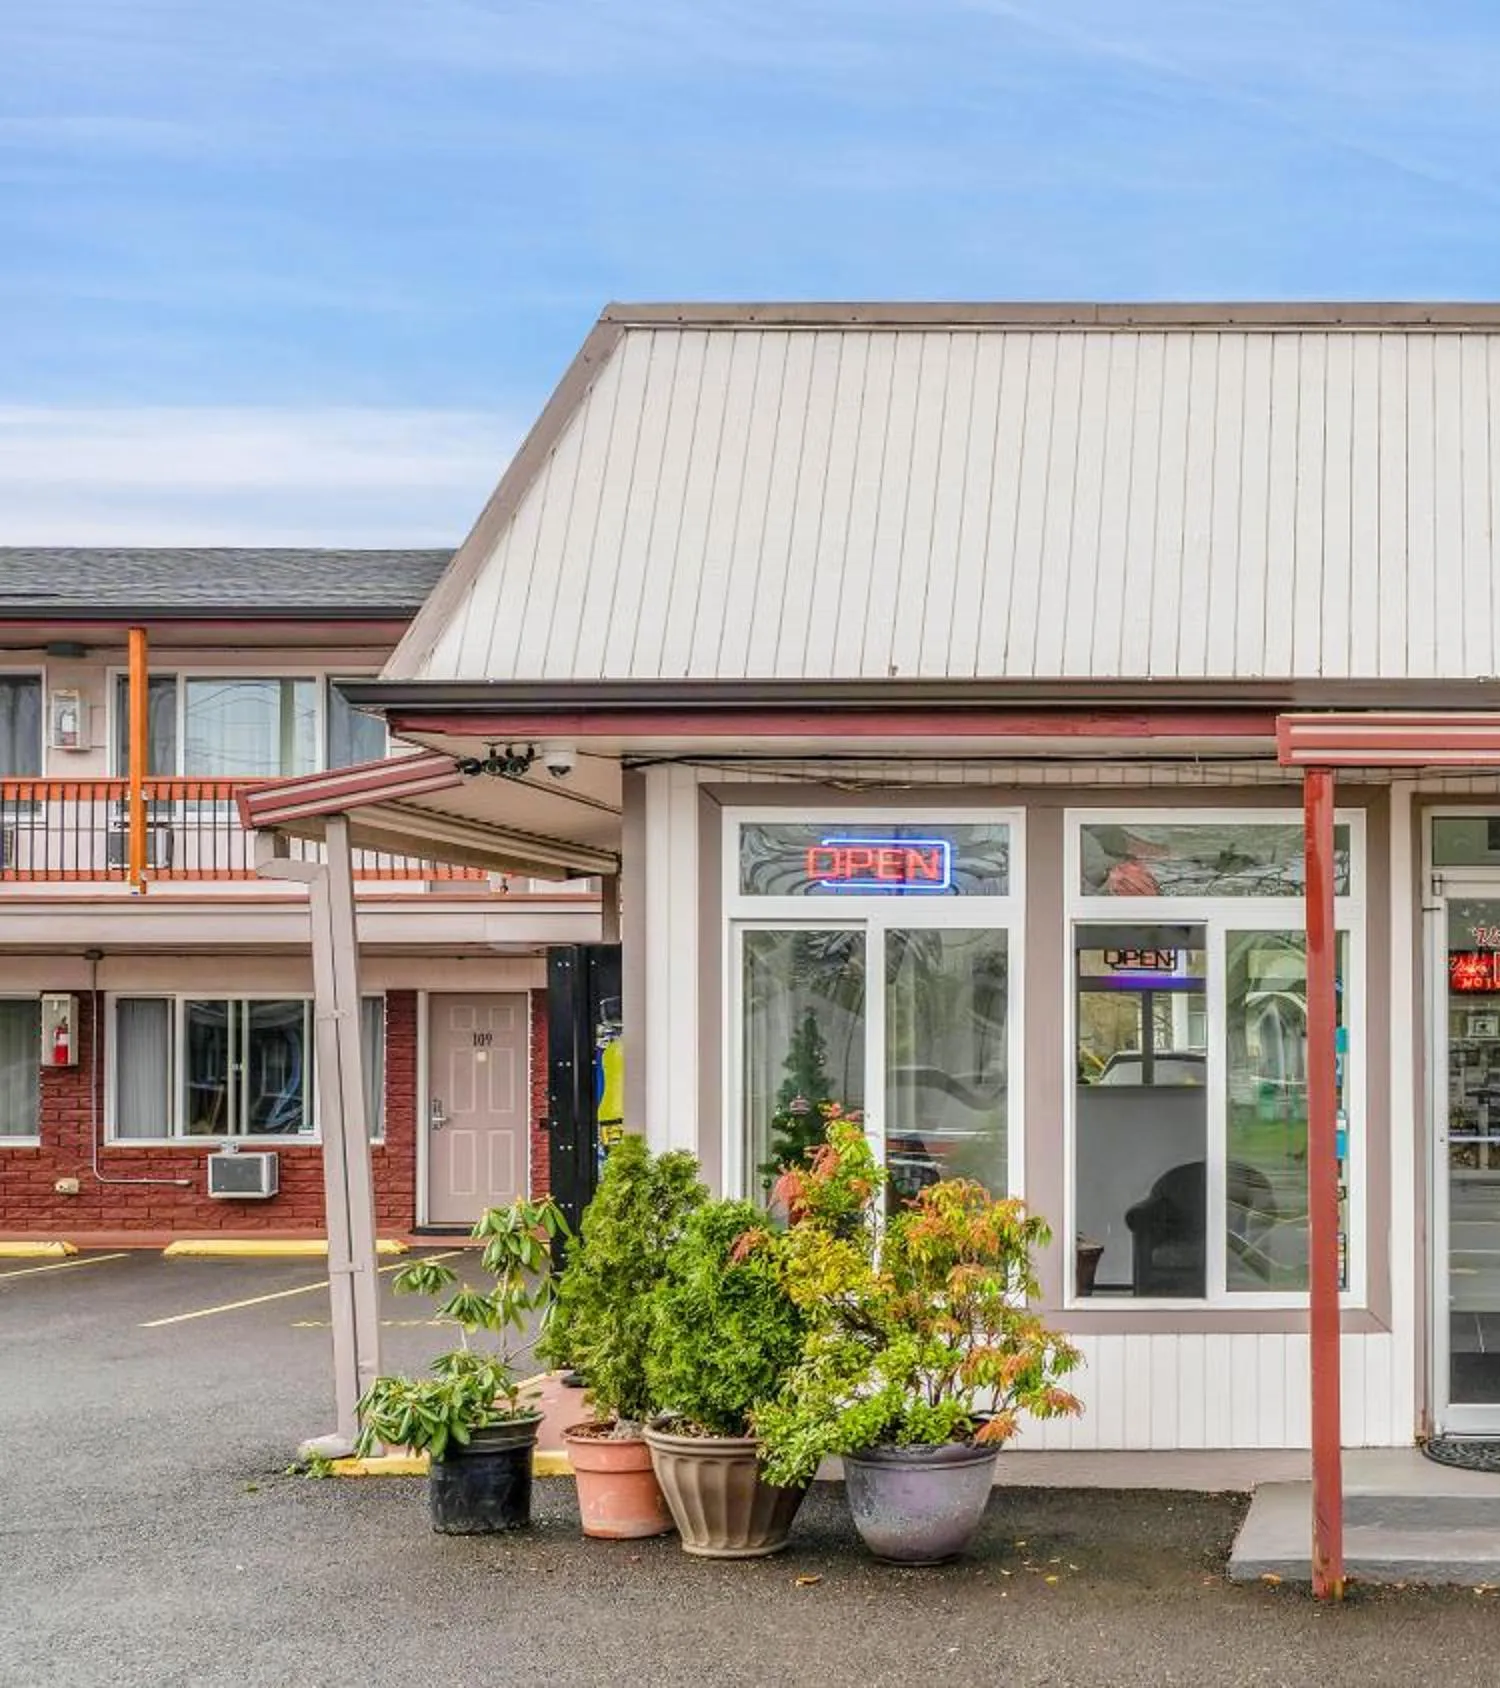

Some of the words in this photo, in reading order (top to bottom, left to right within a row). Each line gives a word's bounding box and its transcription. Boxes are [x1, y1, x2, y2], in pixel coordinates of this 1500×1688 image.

[807, 847, 940, 880] OPEN
[1103, 949, 1172, 967] OPEN
[473, 1032, 493, 1047] 109
